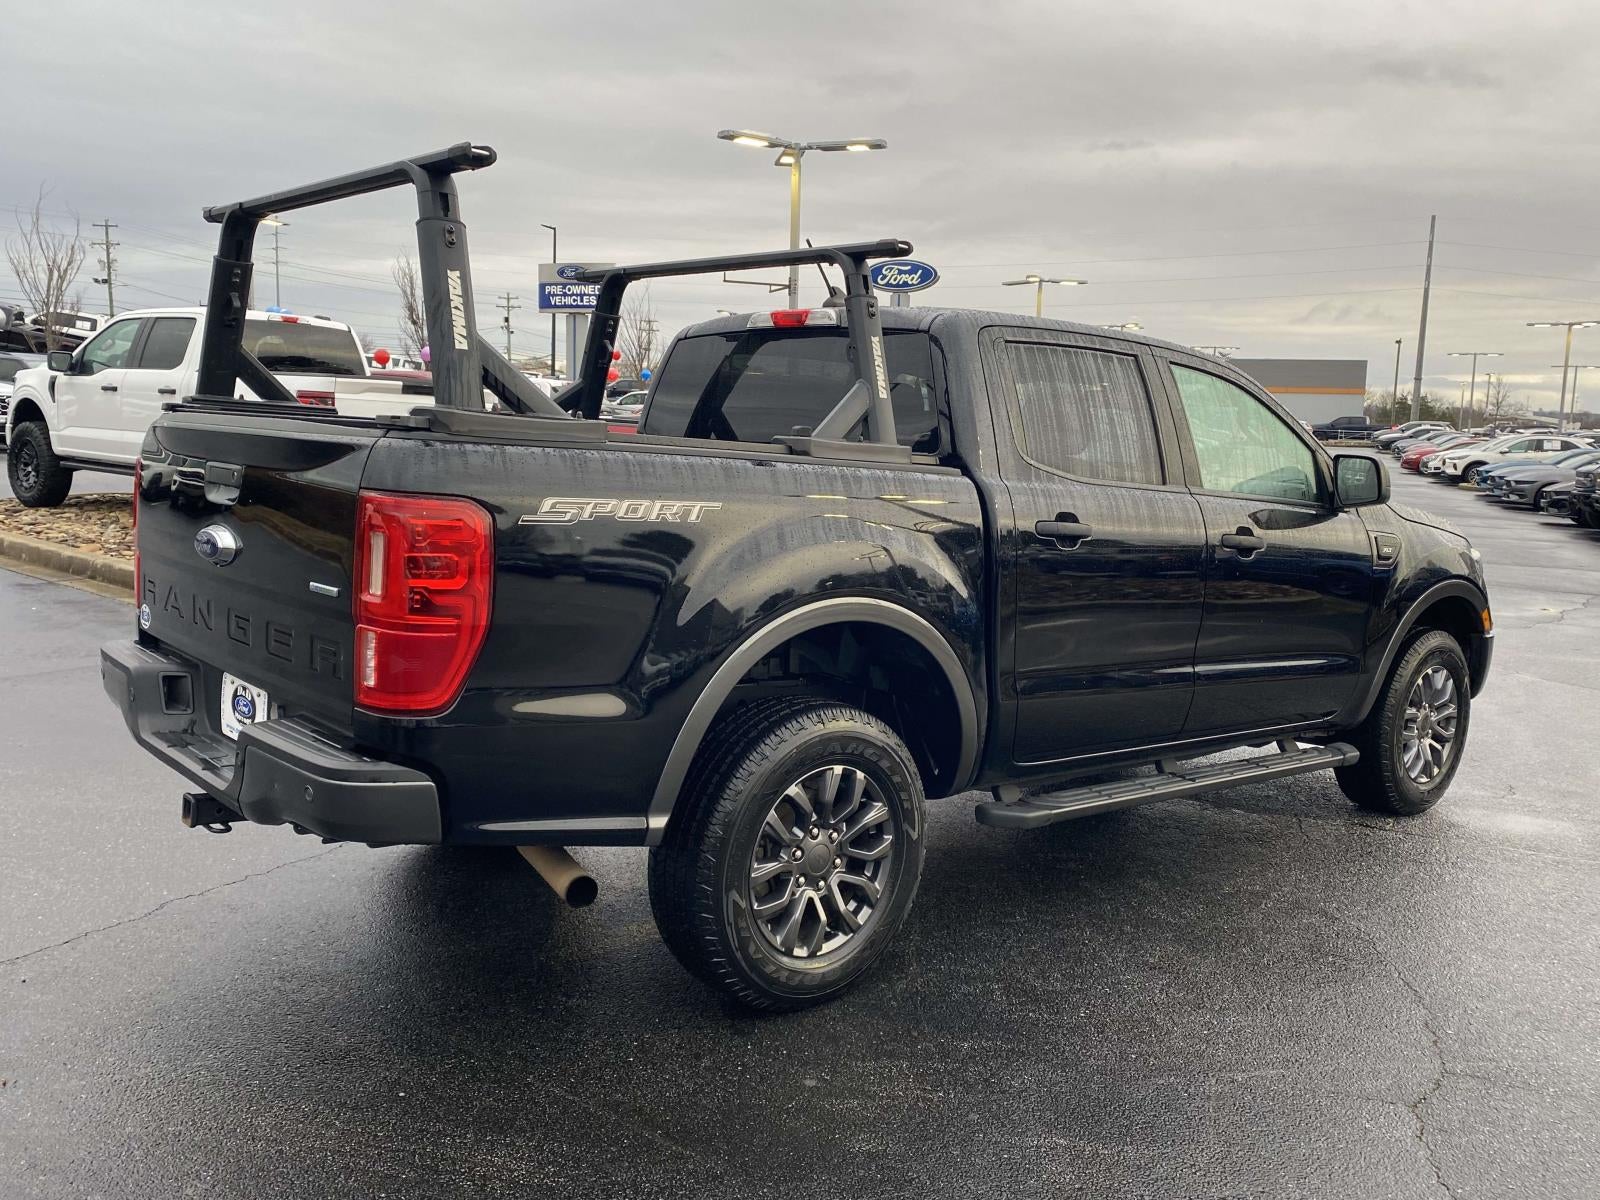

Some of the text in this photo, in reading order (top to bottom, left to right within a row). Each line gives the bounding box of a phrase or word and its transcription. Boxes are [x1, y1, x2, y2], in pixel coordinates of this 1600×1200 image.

[562, 268, 576, 277] For
[877, 265, 922, 285] Ford
[545, 285, 601, 295] PRE-OWNED
[549, 296, 597, 306] VEHICLES
[447, 269, 468, 350] YAKIMA
[871, 335, 888, 399] YAKIMA
[518, 497, 722, 525] SPORT
[143, 573, 343, 681] RANGER
